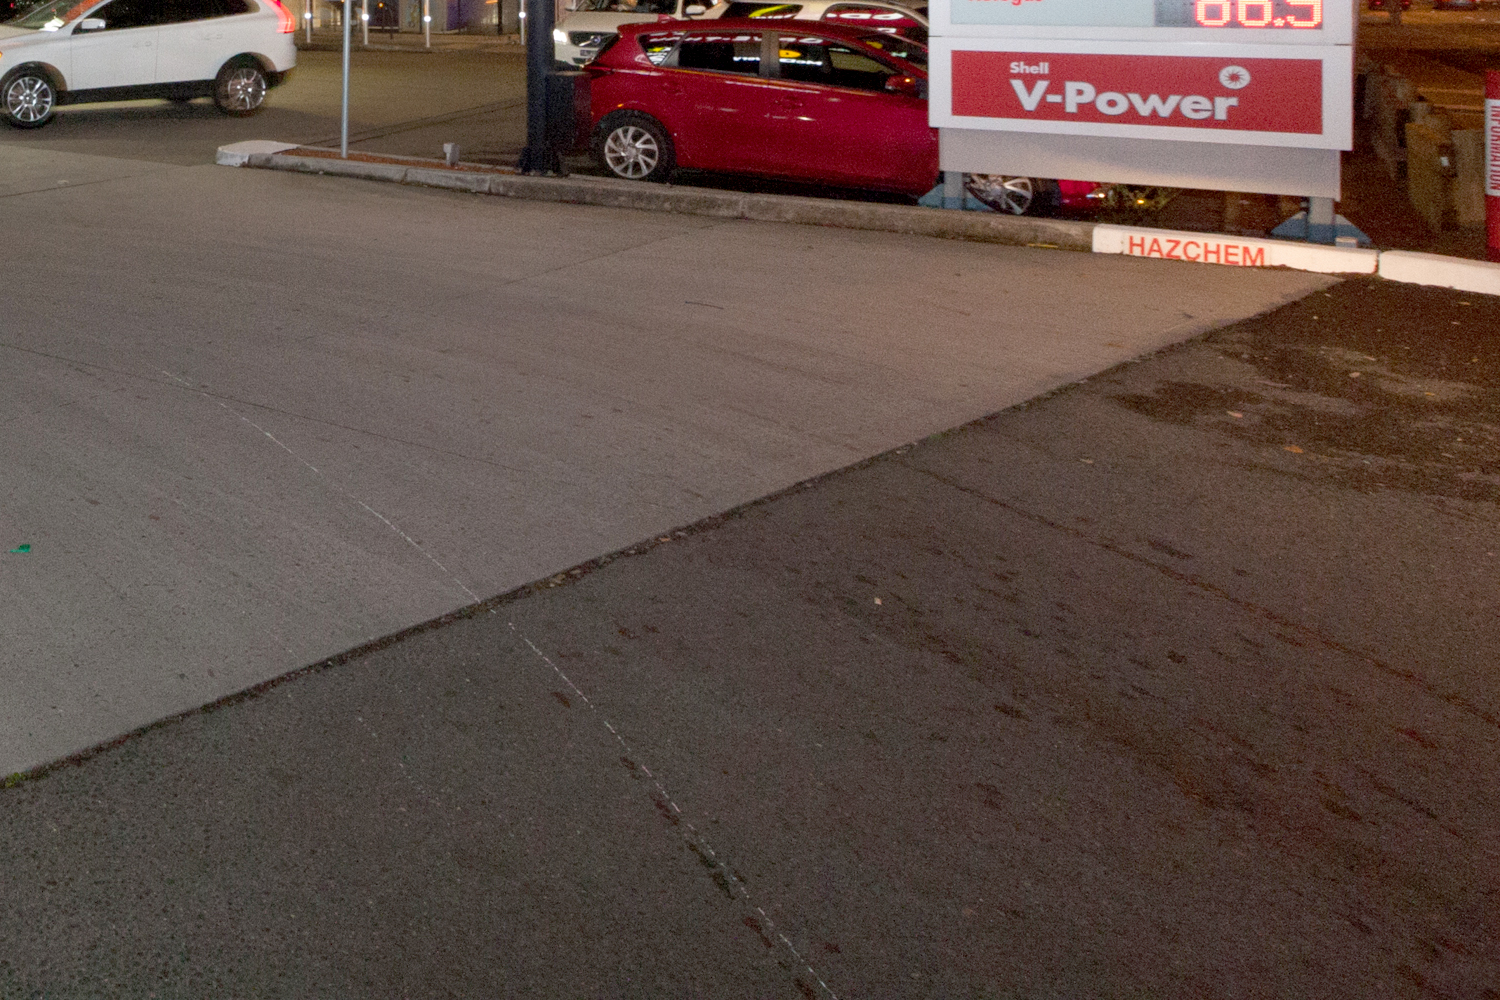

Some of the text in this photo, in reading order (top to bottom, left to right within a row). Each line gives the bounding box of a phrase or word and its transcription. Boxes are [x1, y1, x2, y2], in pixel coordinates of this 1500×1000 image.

[1010, 61, 1049, 75] Shell
[1010, 78, 1239, 121] V-Power
[1128, 235, 1265, 266] HAZCHEM
